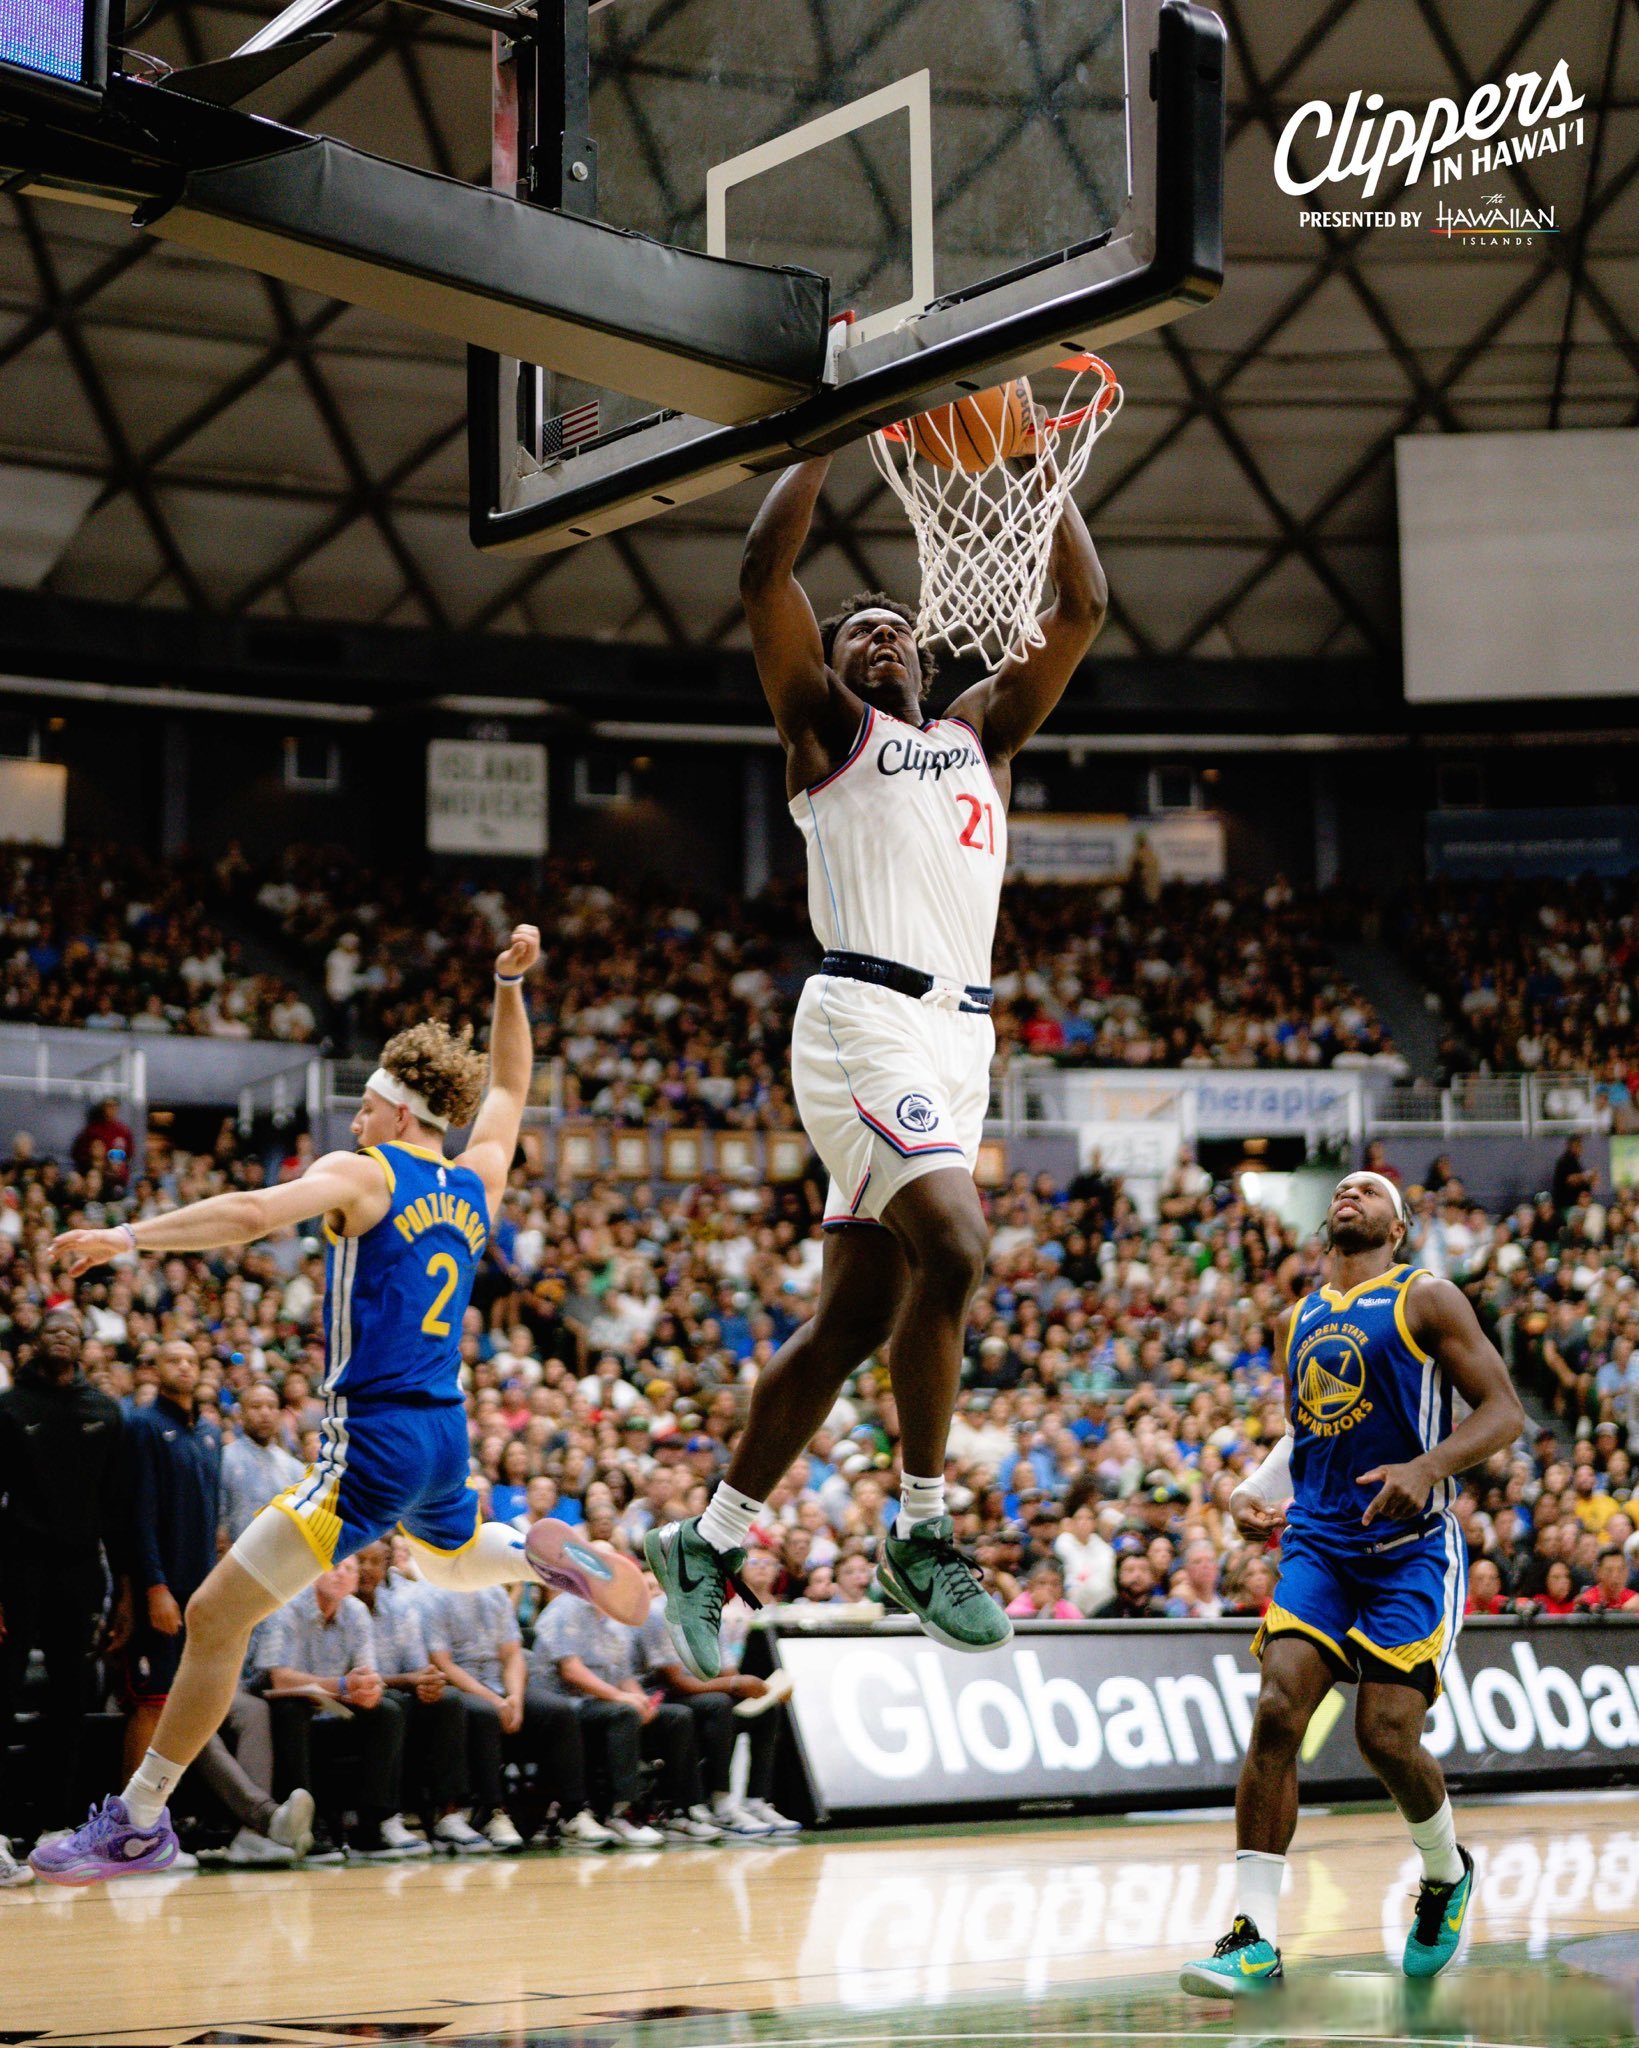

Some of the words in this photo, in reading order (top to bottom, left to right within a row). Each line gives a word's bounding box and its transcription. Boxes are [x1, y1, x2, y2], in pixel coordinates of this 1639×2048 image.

[955, 792, 995, 856] 21
[420, 1252, 459, 1338] 2
[1356, 1297, 1392, 1307] Rakuten
[1297, 1322, 1339, 1358] GOLDEN
[1341, 1322, 1369, 1346] STATE
[1339, 1350, 1352, 1376] 7
[1297, 1398, 1374, 1438] WARRIORS
[830, 1649, 1262, 1780] Globant
[1419, 1640, 1639, 1758] loba
